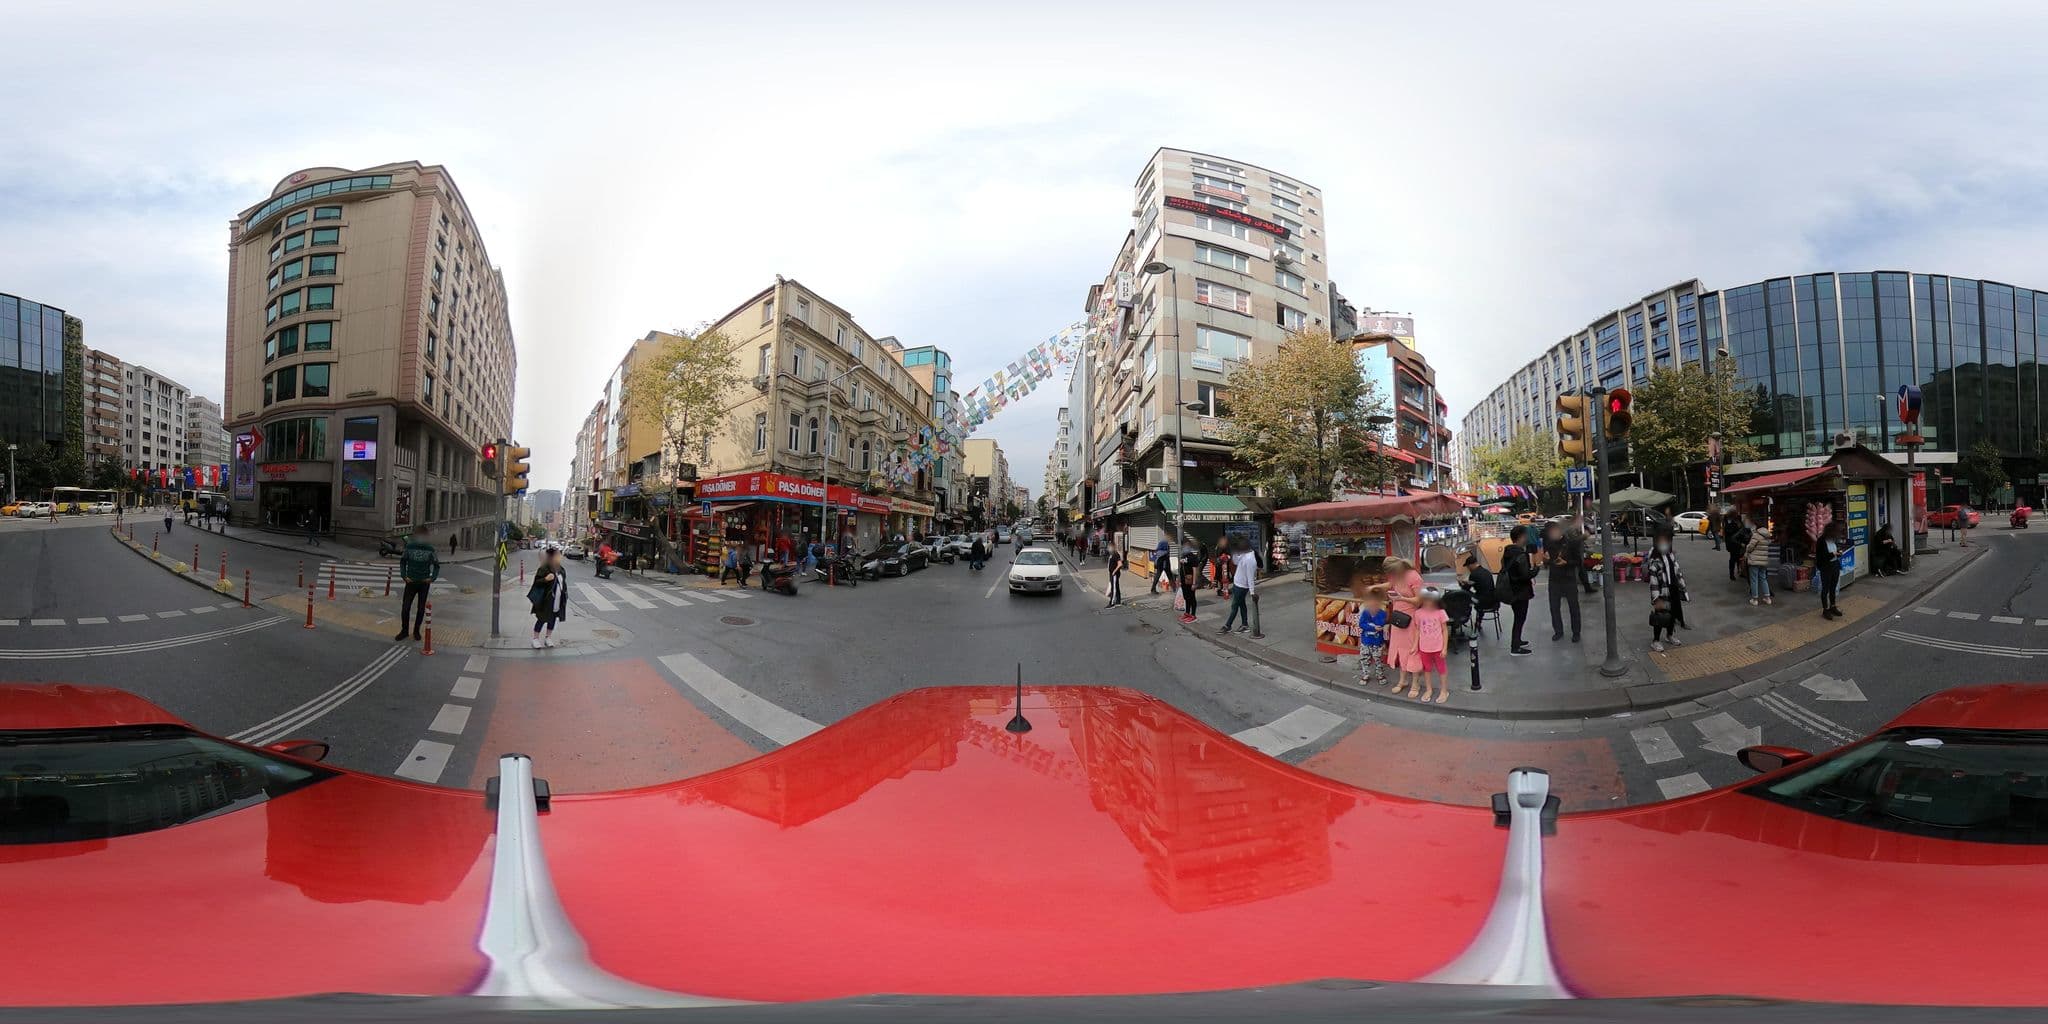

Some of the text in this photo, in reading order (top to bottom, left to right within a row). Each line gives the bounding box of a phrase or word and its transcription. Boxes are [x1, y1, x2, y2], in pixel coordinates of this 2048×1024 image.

[702, 480, 736, 495] PAŞA DÖNER
[778, 480, 825, 497] PAŞA DÖNER
